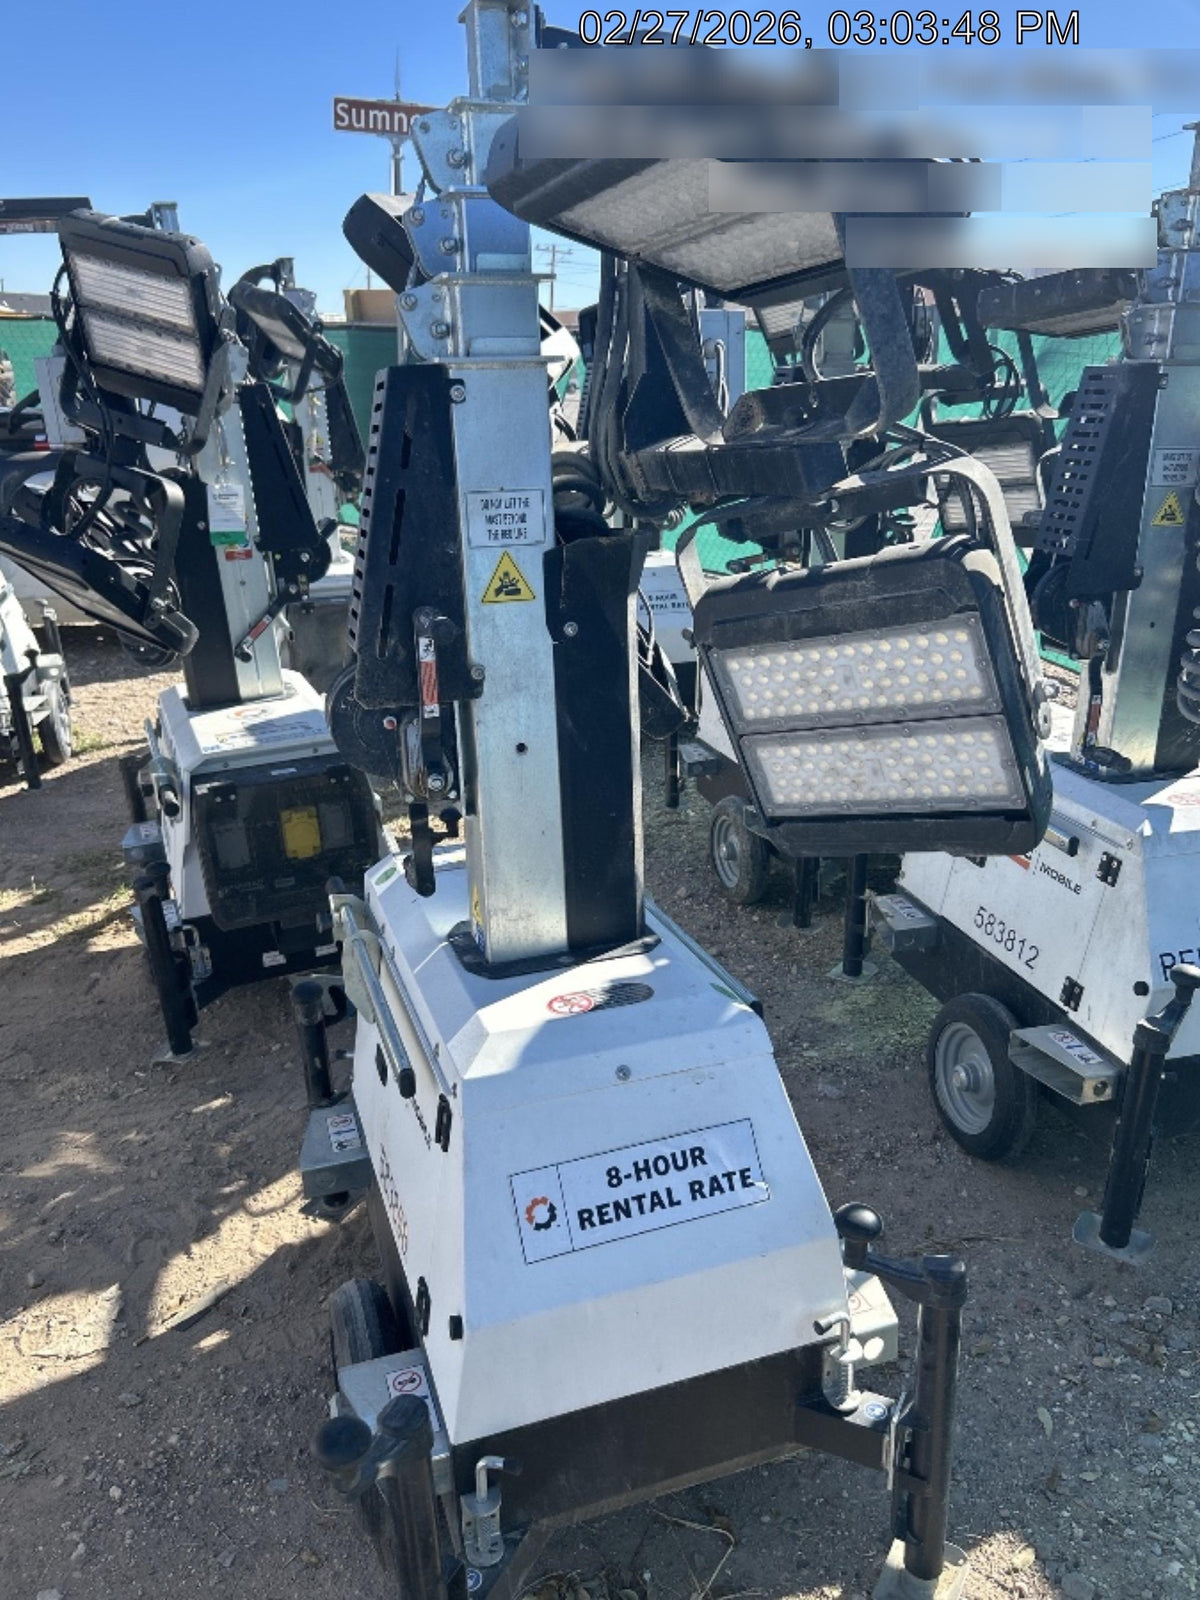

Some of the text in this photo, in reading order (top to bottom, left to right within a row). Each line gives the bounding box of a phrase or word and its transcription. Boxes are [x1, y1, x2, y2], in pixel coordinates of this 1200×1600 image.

[974, 905, 1040, 971] 583812
[577, 1167, 756, 1231] RENTAL RATE
[605, 1146, 708, 1188] 8-HOUR
